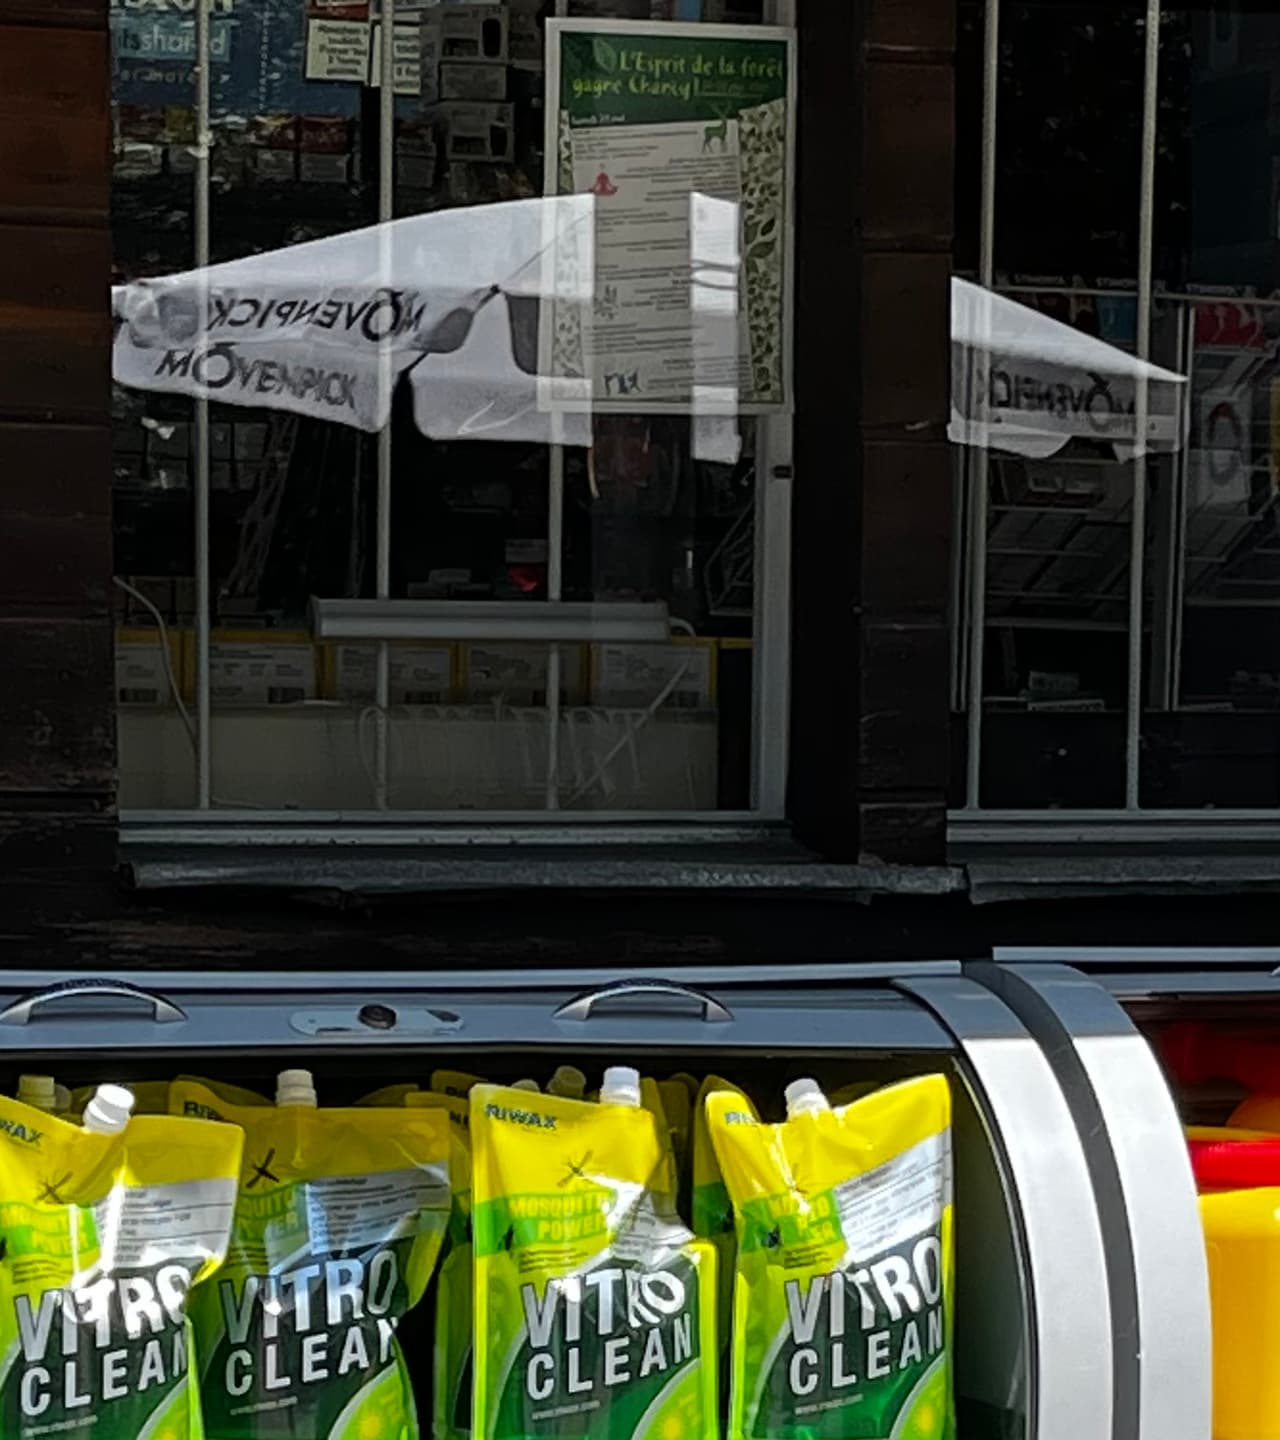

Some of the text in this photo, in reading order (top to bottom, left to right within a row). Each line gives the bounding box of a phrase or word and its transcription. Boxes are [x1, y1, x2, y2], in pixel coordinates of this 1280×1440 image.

[692, 55, 710, 73] de
[720, 56, 736, 74] la
[485, 1102, 559, 1131] RIWAX
[14, 1264, 190, 1363] VITRO
[219, 1249, 397, 1346] VITRO
[522, 1266, 685, 1348] VITRO
[784, 1235, 942, 1346] VITRO
[20, 1330, 189, 1417] CLEAN
[224, 1317, 400, 1399] CLEAN
[526, 1313, 693, 1401] CLEAN
[788, 1313, 944, 1396] CLEAN
